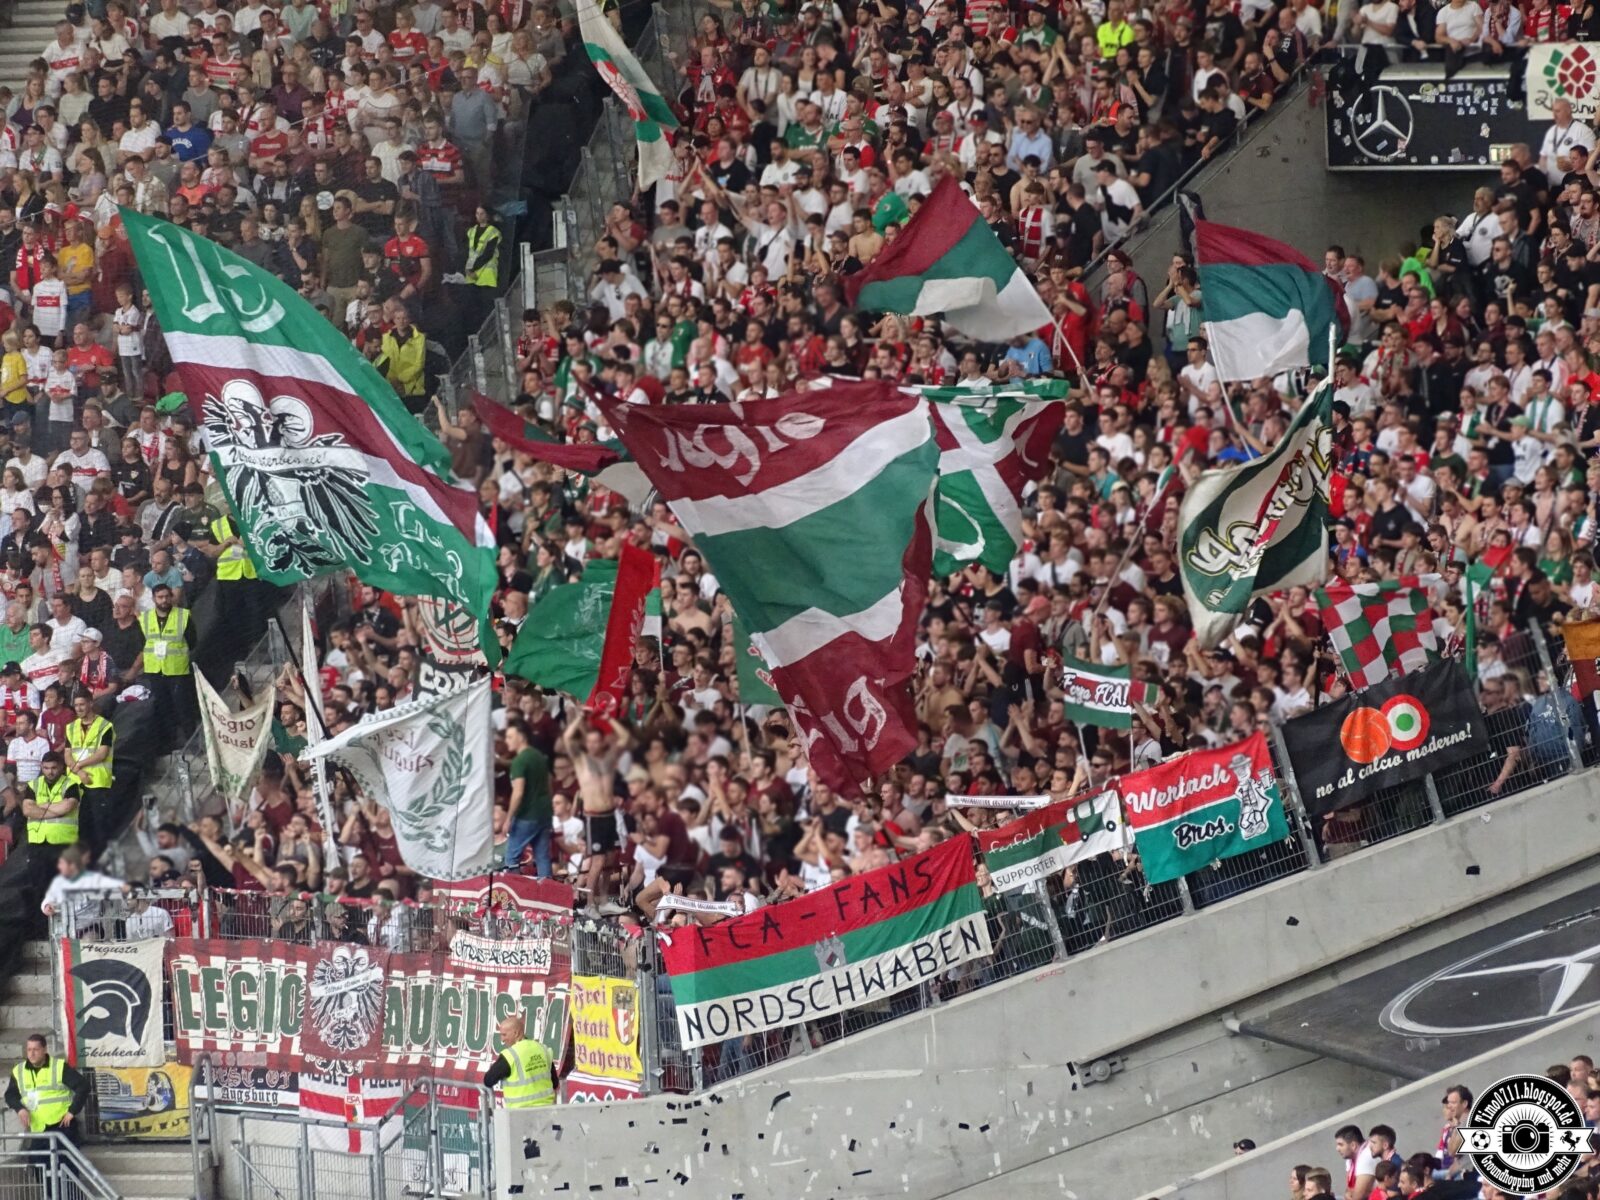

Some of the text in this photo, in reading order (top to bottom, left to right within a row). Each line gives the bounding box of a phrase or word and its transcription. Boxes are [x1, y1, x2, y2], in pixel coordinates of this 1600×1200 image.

[1094, 681, 1130, 707] FCA!
[1315, 722, 1472, 798] no al calcio moderno!
[1125, 762, 1231, 815] Wertach
[1173, 816, 1235, 850] Bros.
[995, 856, 1057, 887] SUPPORTER
[698, 912, 784, 957] FCA
[833, 856, 933, 921] FANS
[81, 944, 139, 955] Augusta
[573, 982, 606, 1011] Frei
[683, 920, 982, 1042] NORDSCHWABEN
[175, 967, 302, 1037] LEGIO
[383, 984, 566, 1063] AUGUSTA
[576, 1044, 633, 1073] Bayern
[221, 1087, 279, 1106] Augsburg
